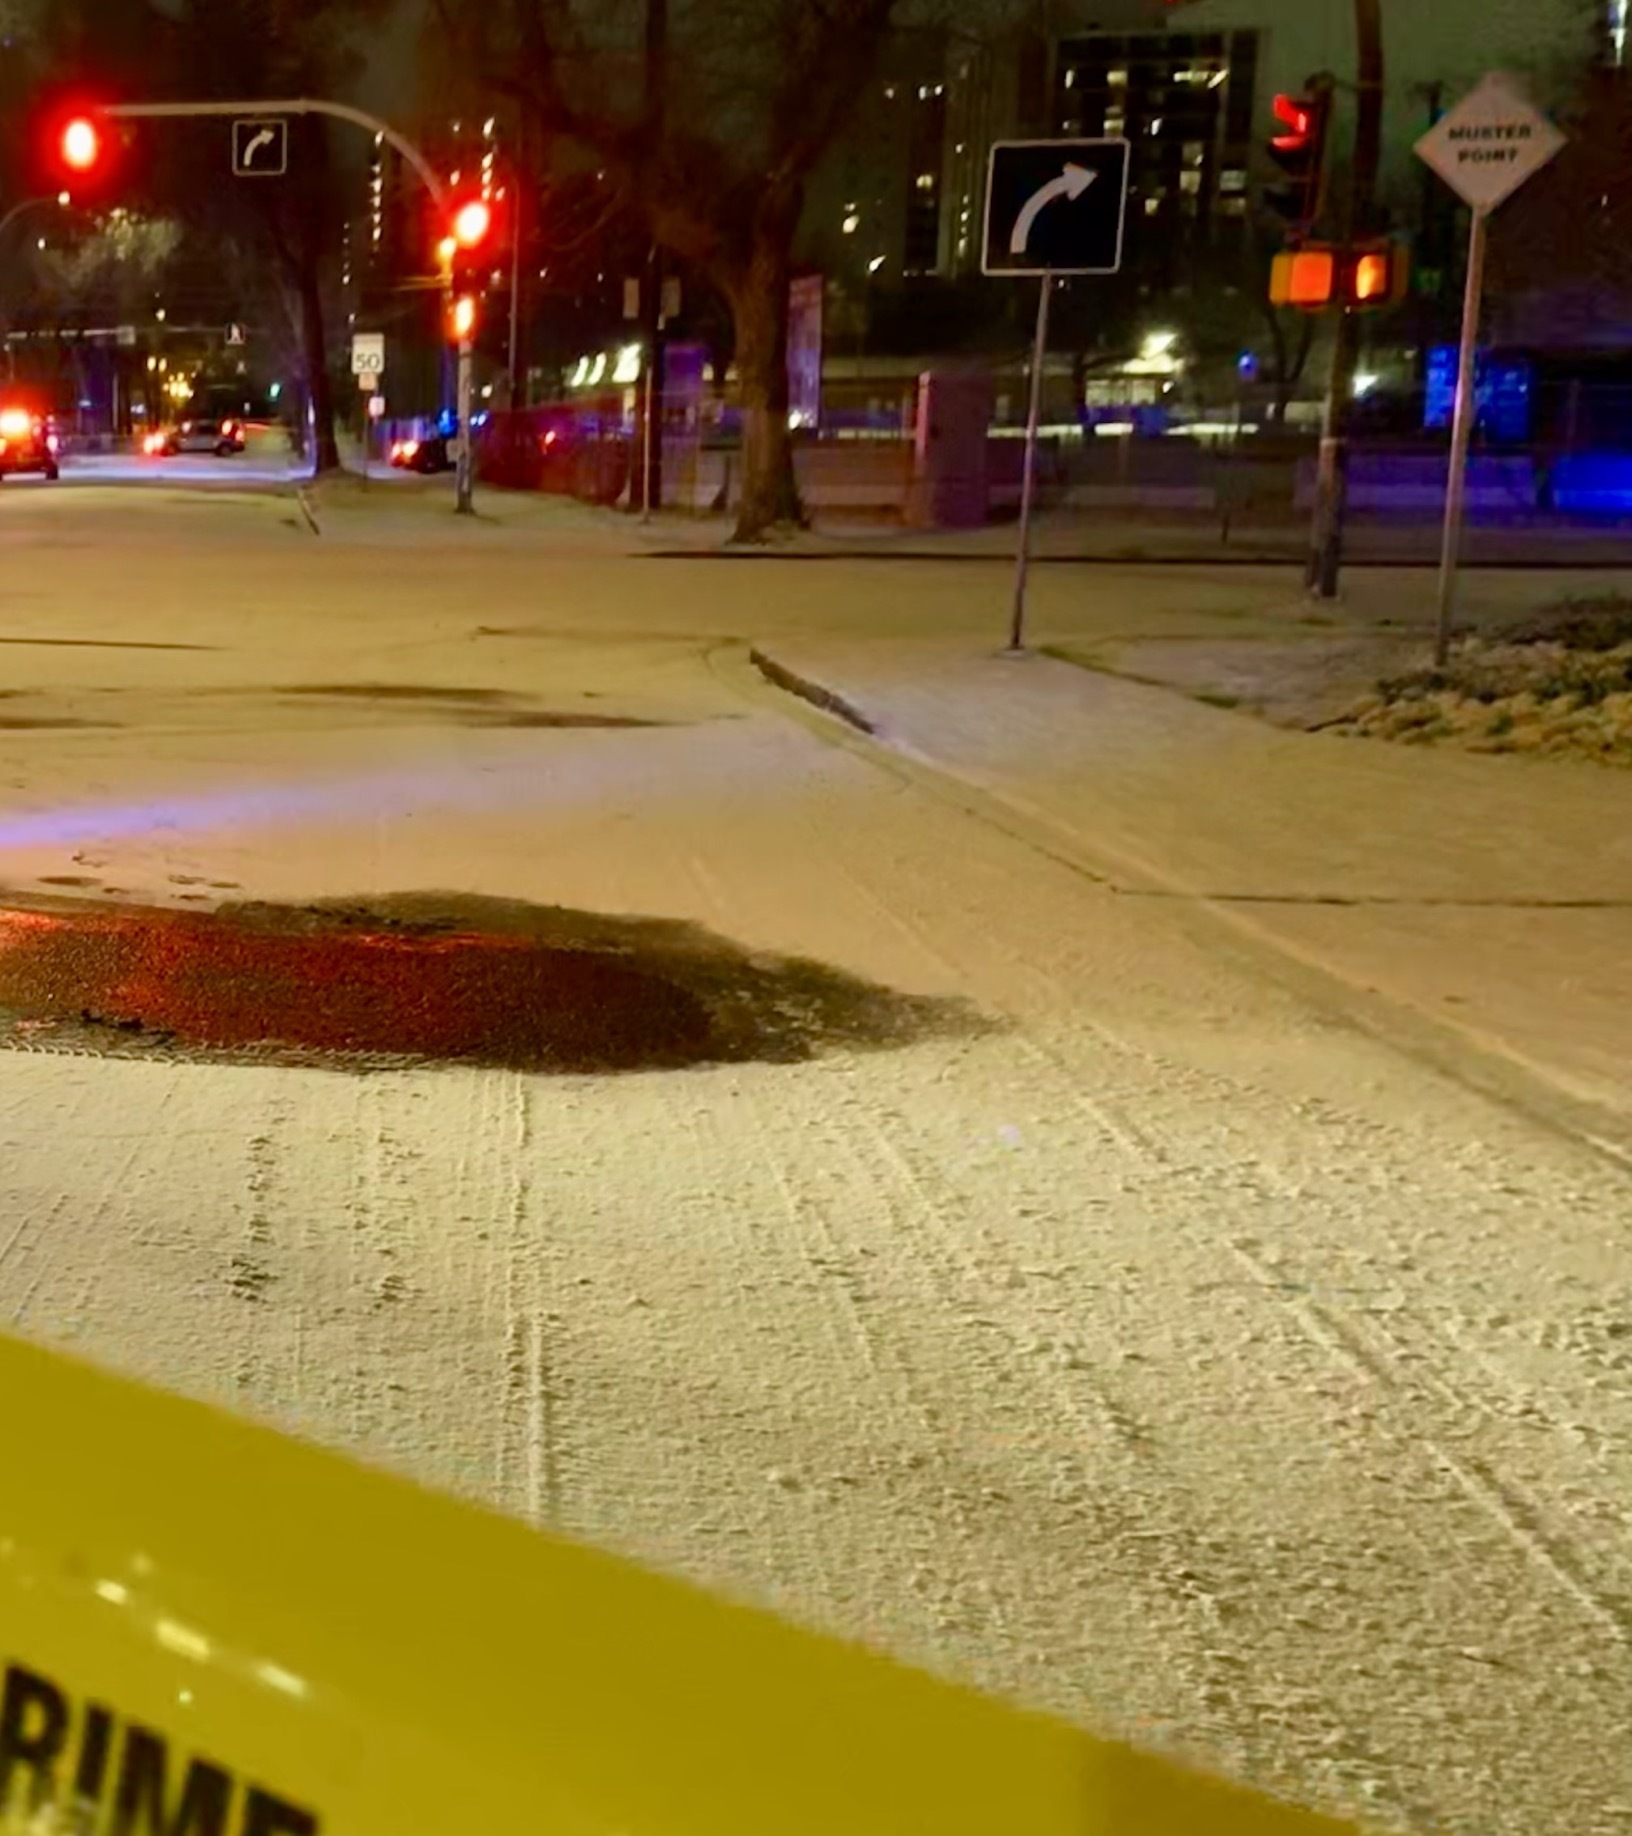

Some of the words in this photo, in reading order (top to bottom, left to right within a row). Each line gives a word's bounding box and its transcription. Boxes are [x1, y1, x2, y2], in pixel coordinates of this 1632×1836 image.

[1447, 123, 1532, 141] MUSTER
[1457, 147, 1518, 163] POINT
[356, 353, 380, 370] 50
